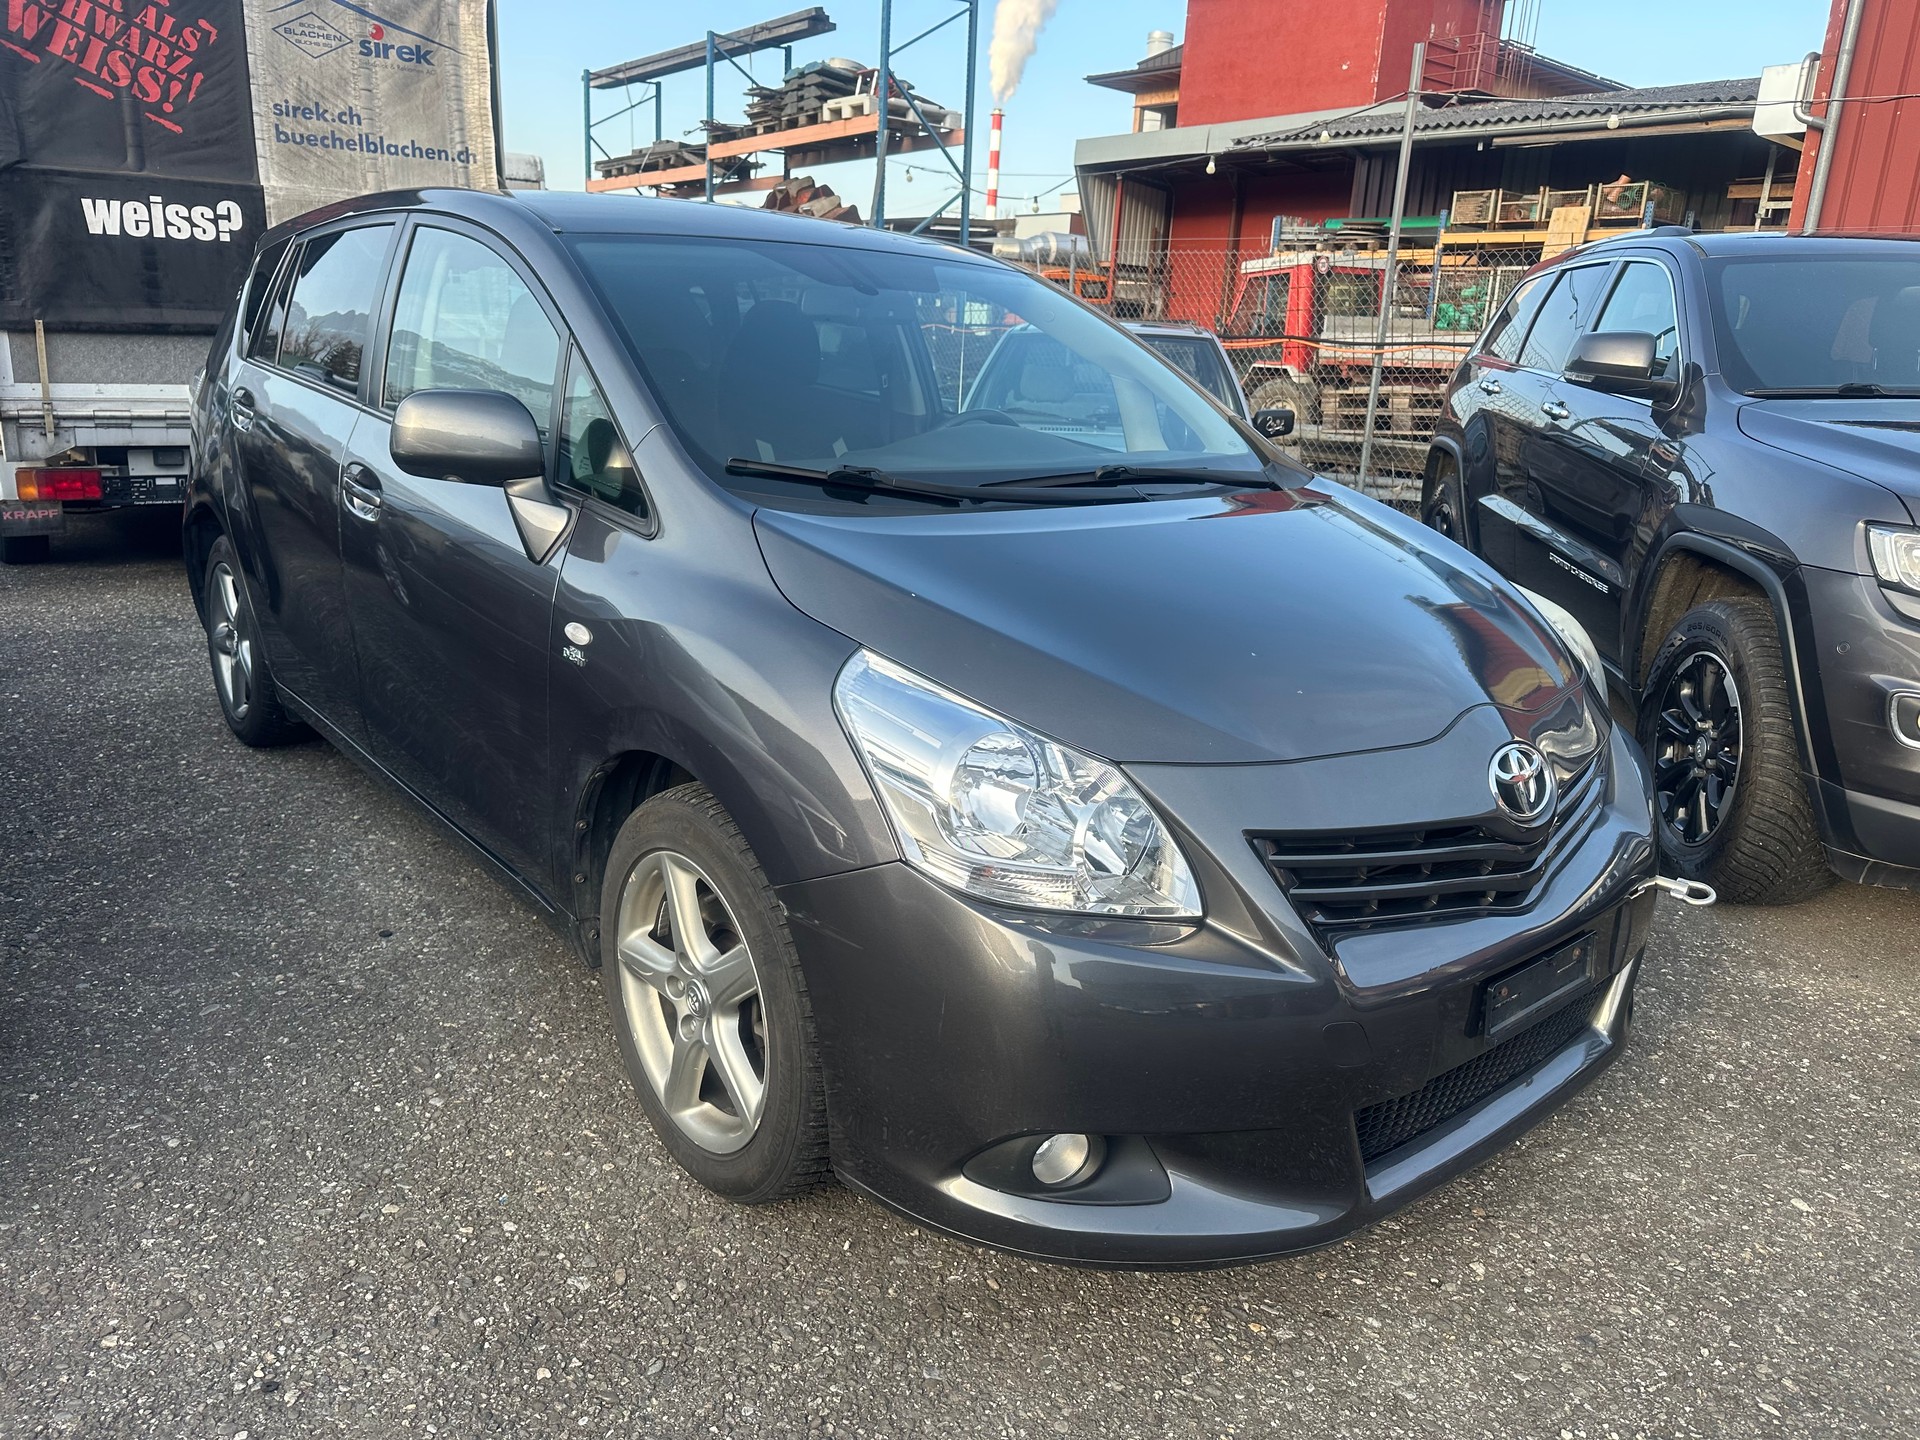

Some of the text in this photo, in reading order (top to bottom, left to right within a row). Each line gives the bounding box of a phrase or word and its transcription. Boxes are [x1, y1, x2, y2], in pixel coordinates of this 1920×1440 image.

[41, 0, 193, 80] HWARZ
[133, 5, 201, 52] ALS
[283, 27, 342, 42] BLACHEN
[358, 23, 436, 67] sirek
[272, 99, 362, 126] sirek.ch
[274, 123, 477, 165] buechelblachen.ch
[80, 195, 243, 242] weiss?
[2, 509, 58, 520] KRAPF
